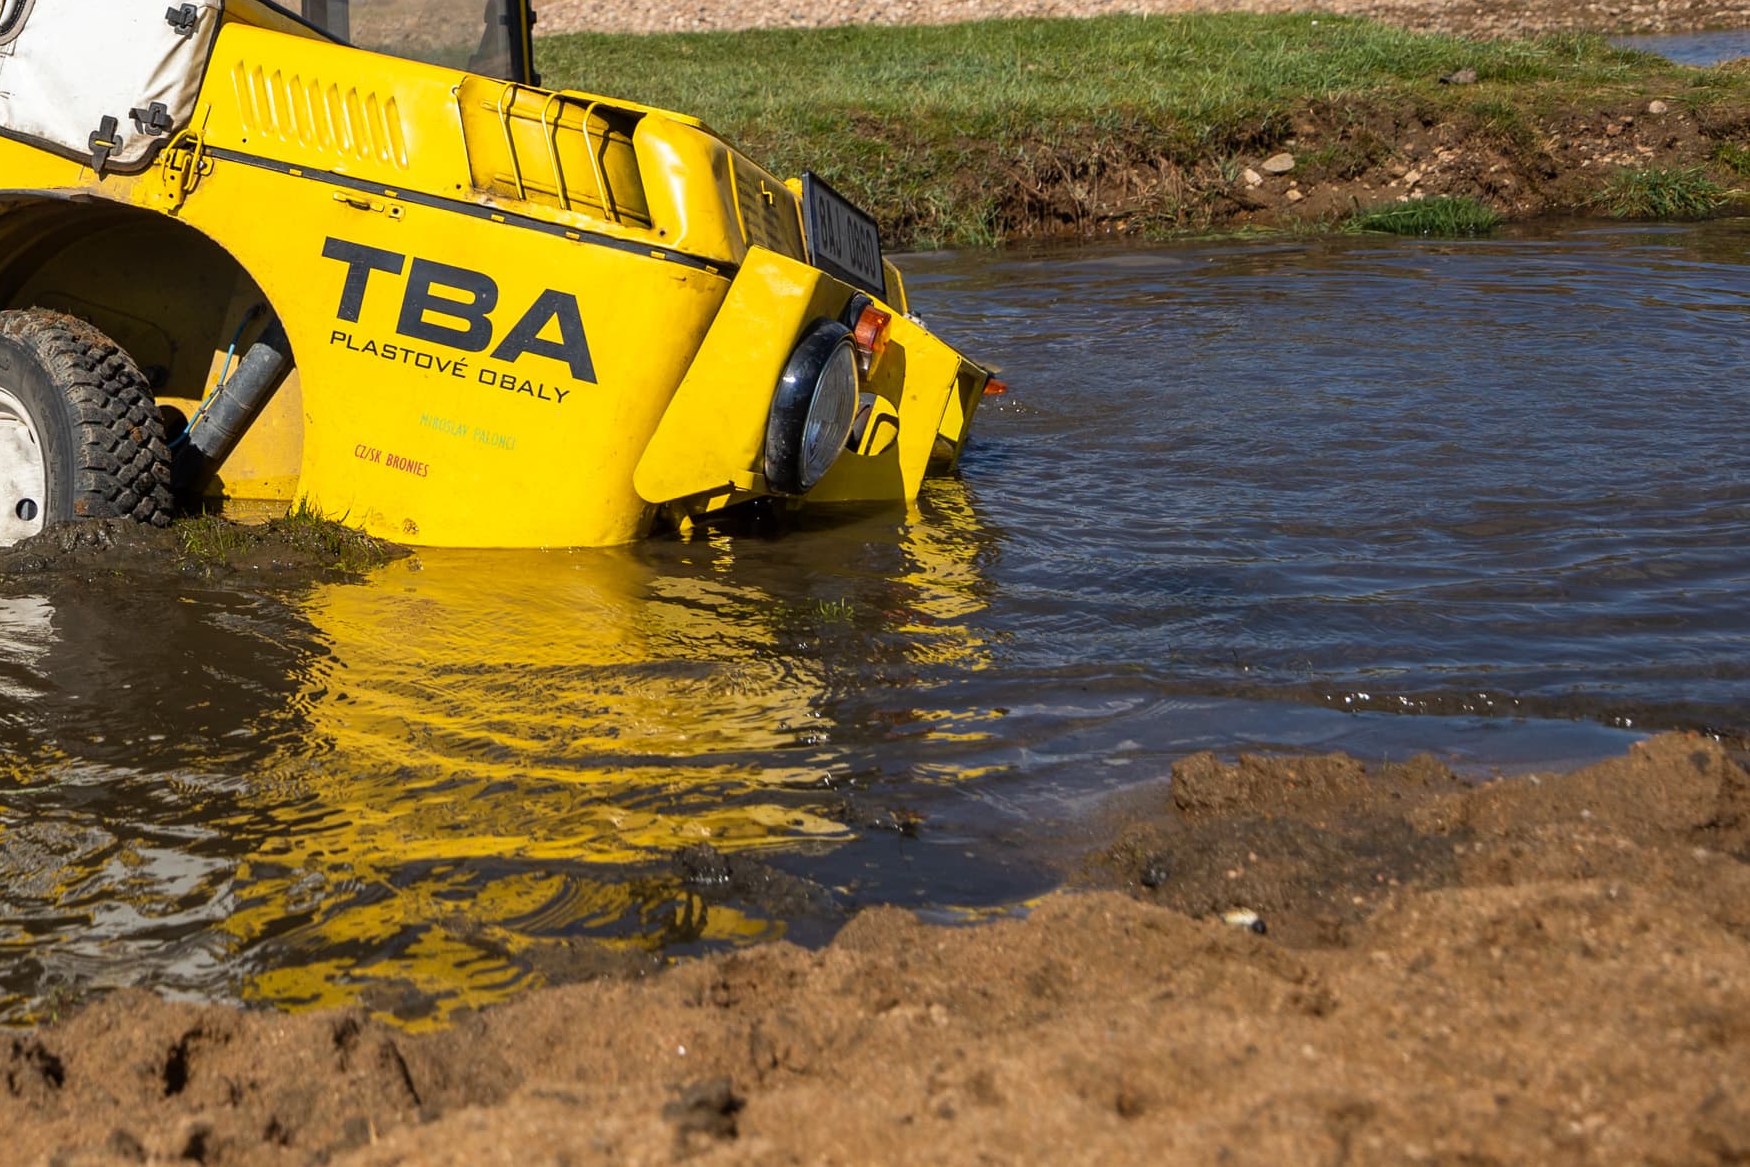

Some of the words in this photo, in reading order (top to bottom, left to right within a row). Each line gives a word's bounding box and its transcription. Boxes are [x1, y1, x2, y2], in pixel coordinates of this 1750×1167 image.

[322, 236, 598, 384] TBA
[330, 330, 468, 379] PLASTOVÉ
[478, 368, 571, 404] OBALY
[354, 443, 382, 463] CZ/SK
[385, 453, 429, 477] BRONIES
